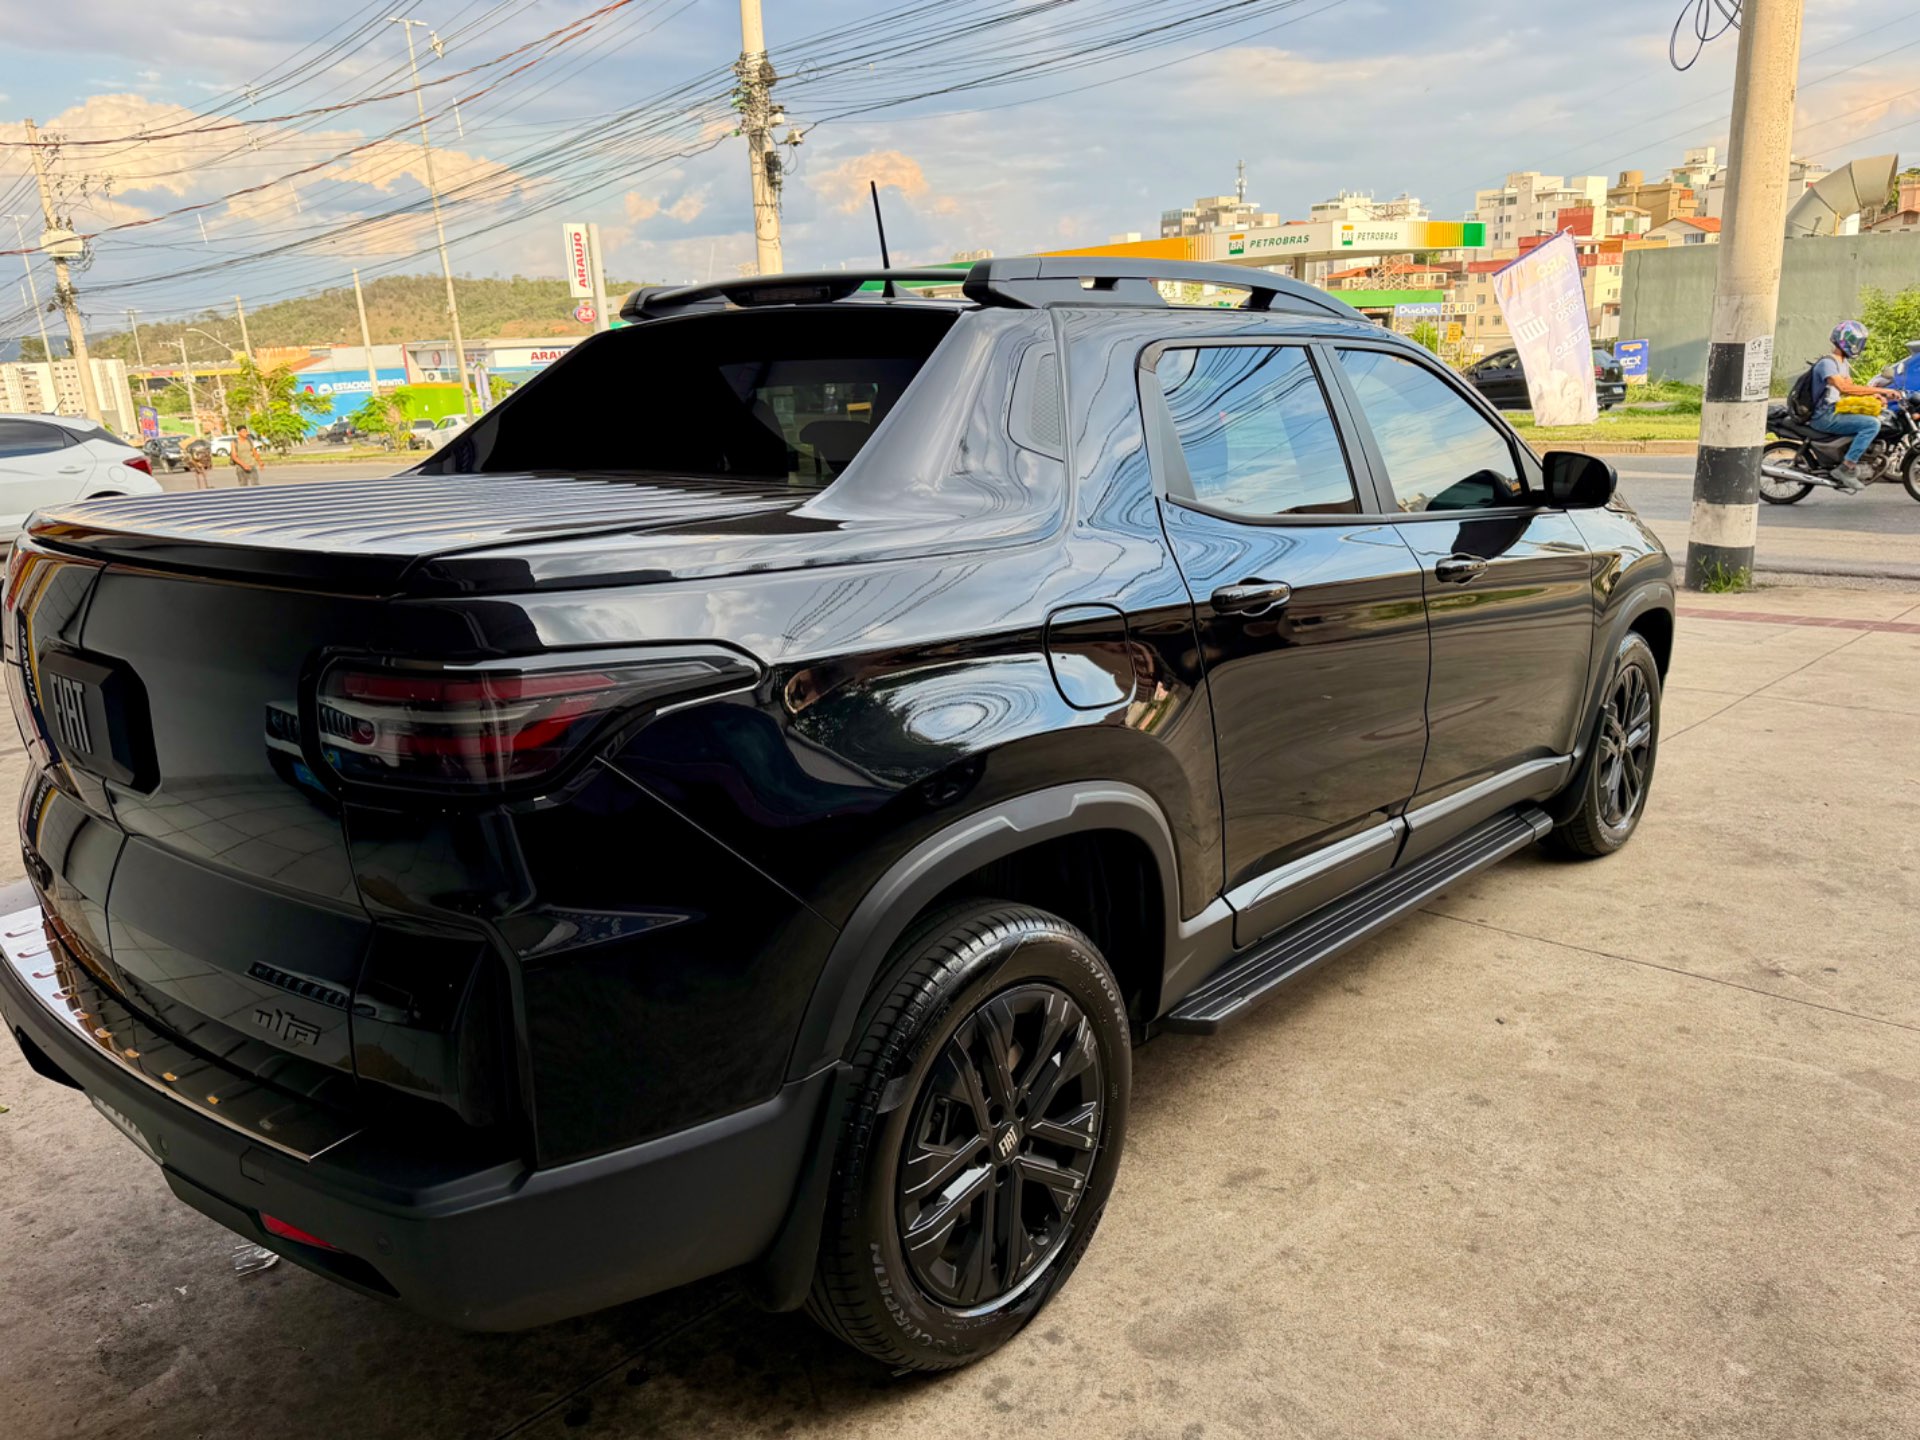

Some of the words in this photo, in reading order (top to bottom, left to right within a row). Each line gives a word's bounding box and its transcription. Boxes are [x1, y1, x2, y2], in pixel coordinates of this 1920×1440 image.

[1249, 234, 1310, 248] PETROBRAS
[1357, 231, 1398, 241] PETROBRAS
[573, 231, 588, 288] ARAUJO
[1399, 305, 1438, 314] Ducha
[1442, 303, 1475, 314] 25.00
[49, 672, 92, 754] FIAT
[998, 1126, 1018, 1157] FIAT
